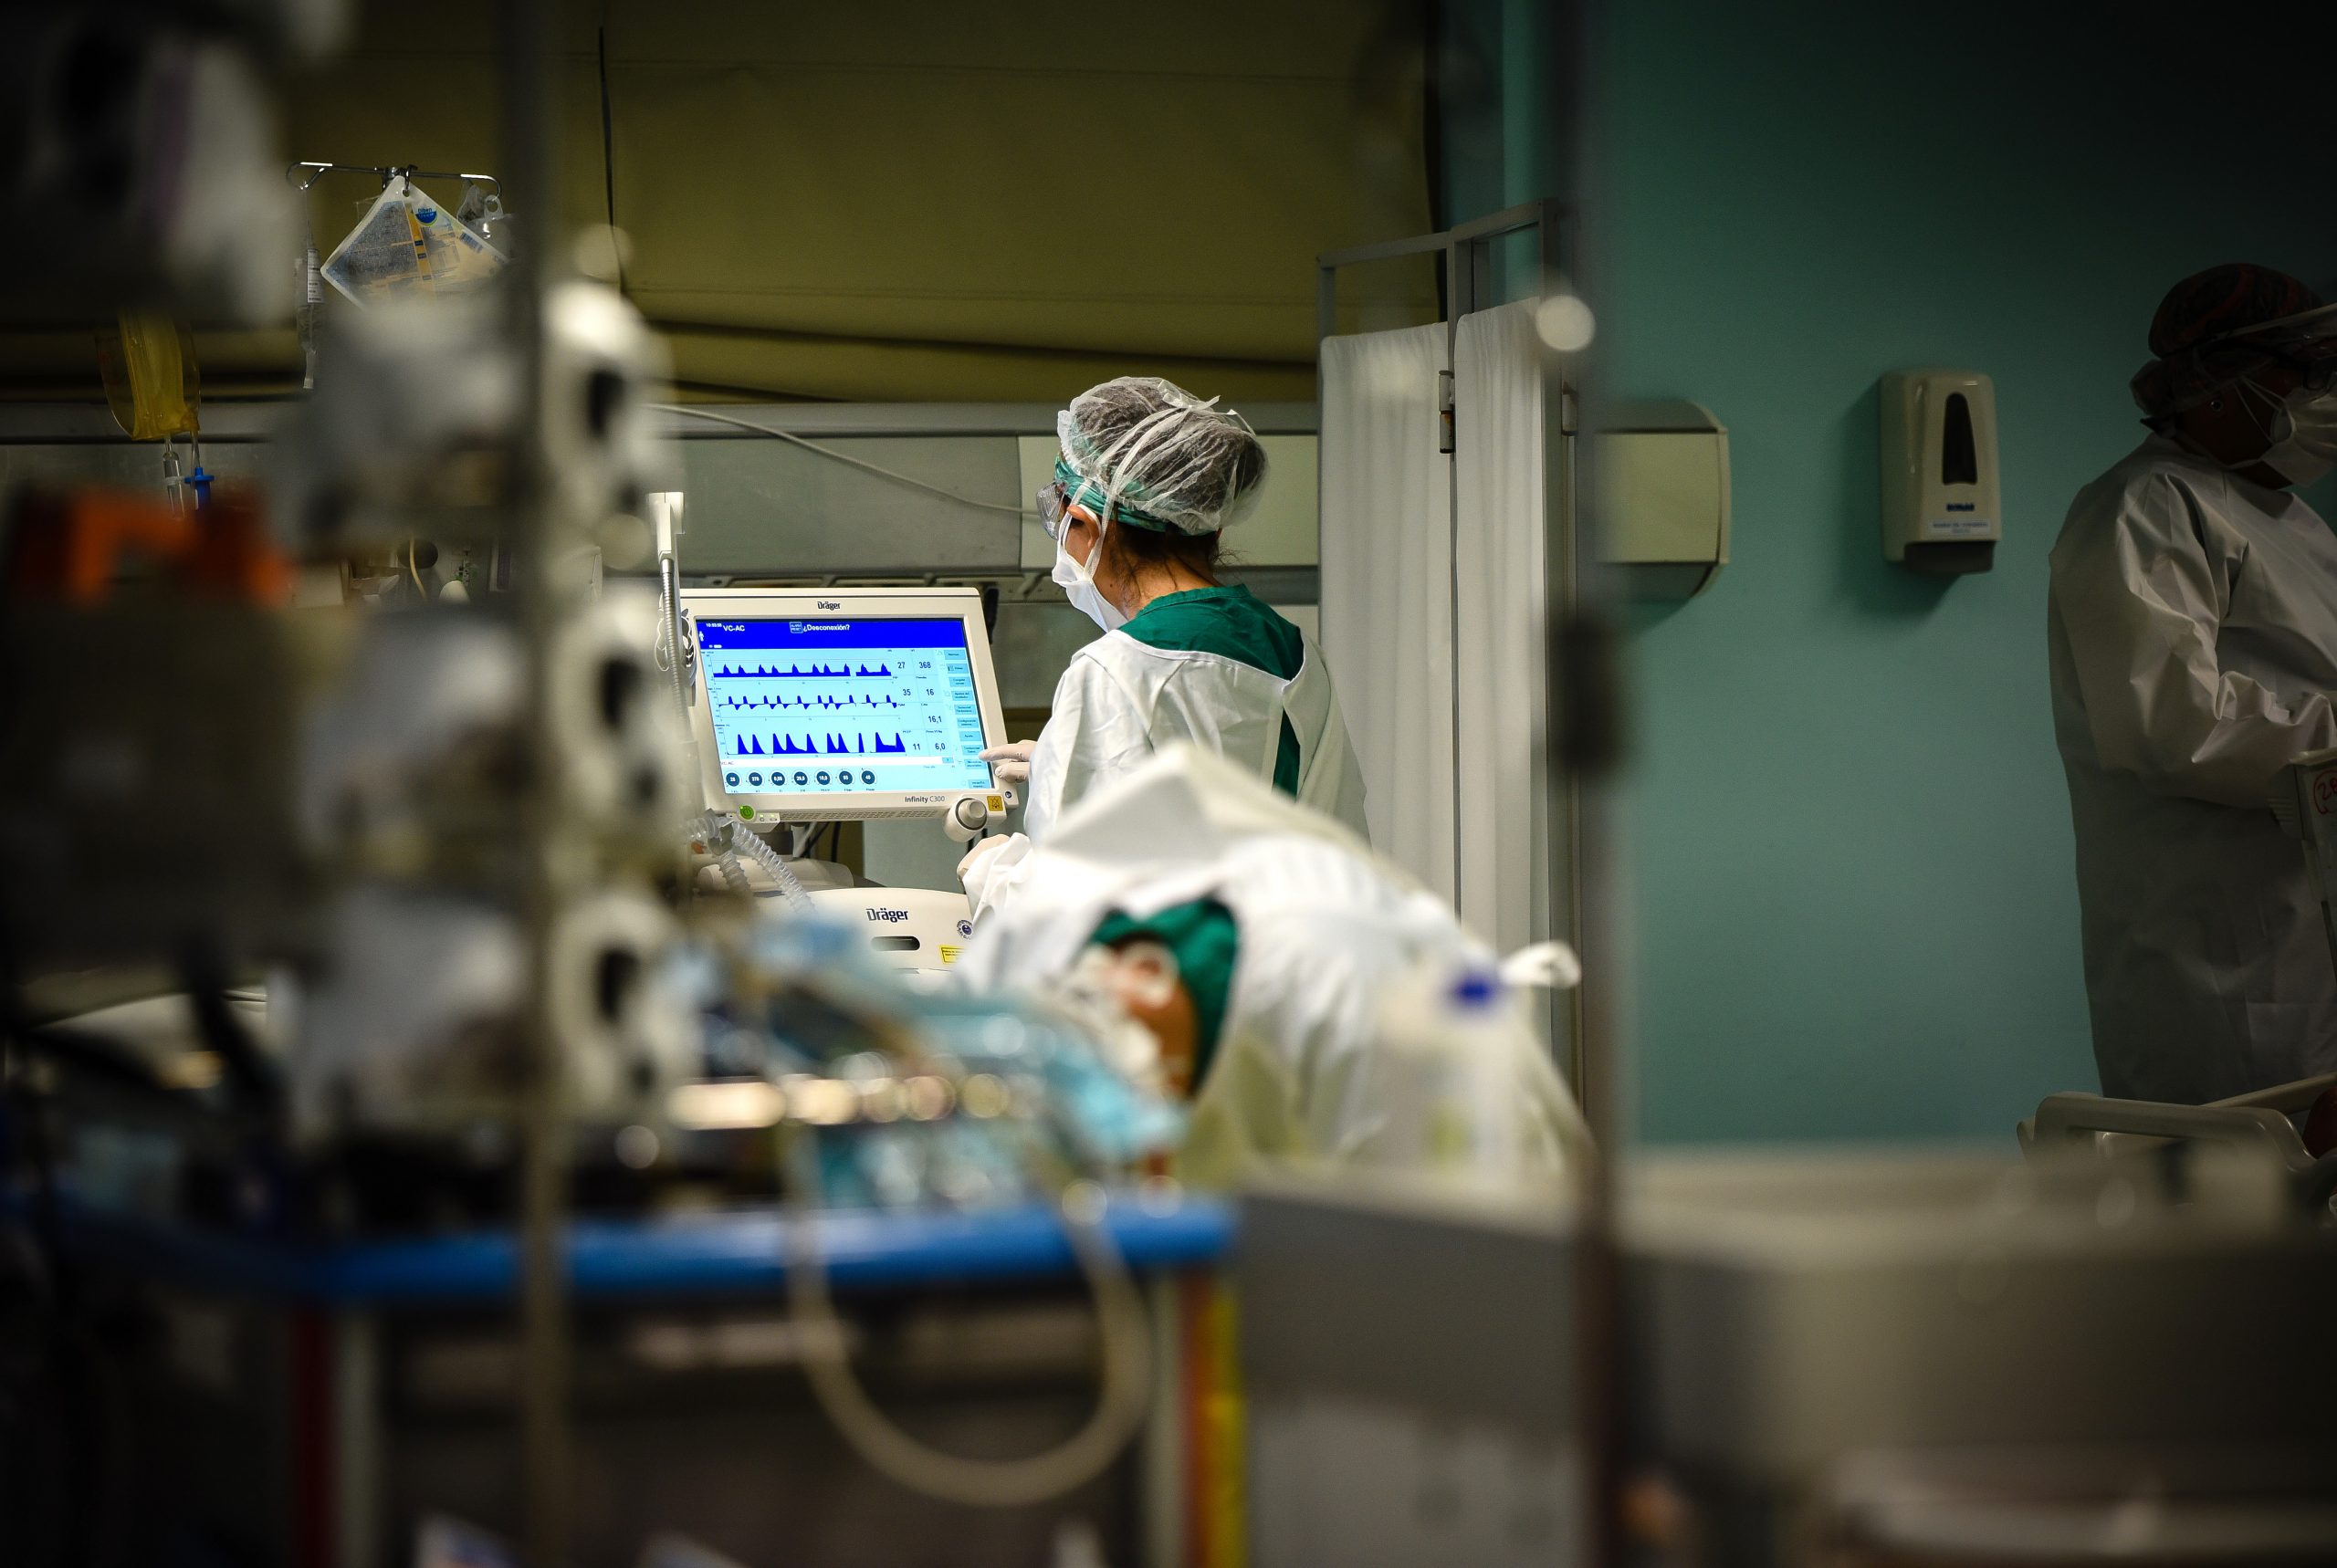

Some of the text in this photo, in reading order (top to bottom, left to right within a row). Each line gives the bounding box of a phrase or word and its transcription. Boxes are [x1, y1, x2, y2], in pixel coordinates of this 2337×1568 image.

[817, 601, 840, 611] Dräger
[803, 624, 850, 632] ¿Desconexión?
[927, 716, 942, 724] 16,1
[935, 743, 946, 752] 6,0
[905, 795, 928, 803] Infinity
[865, 907, 908, 923] Dräger
